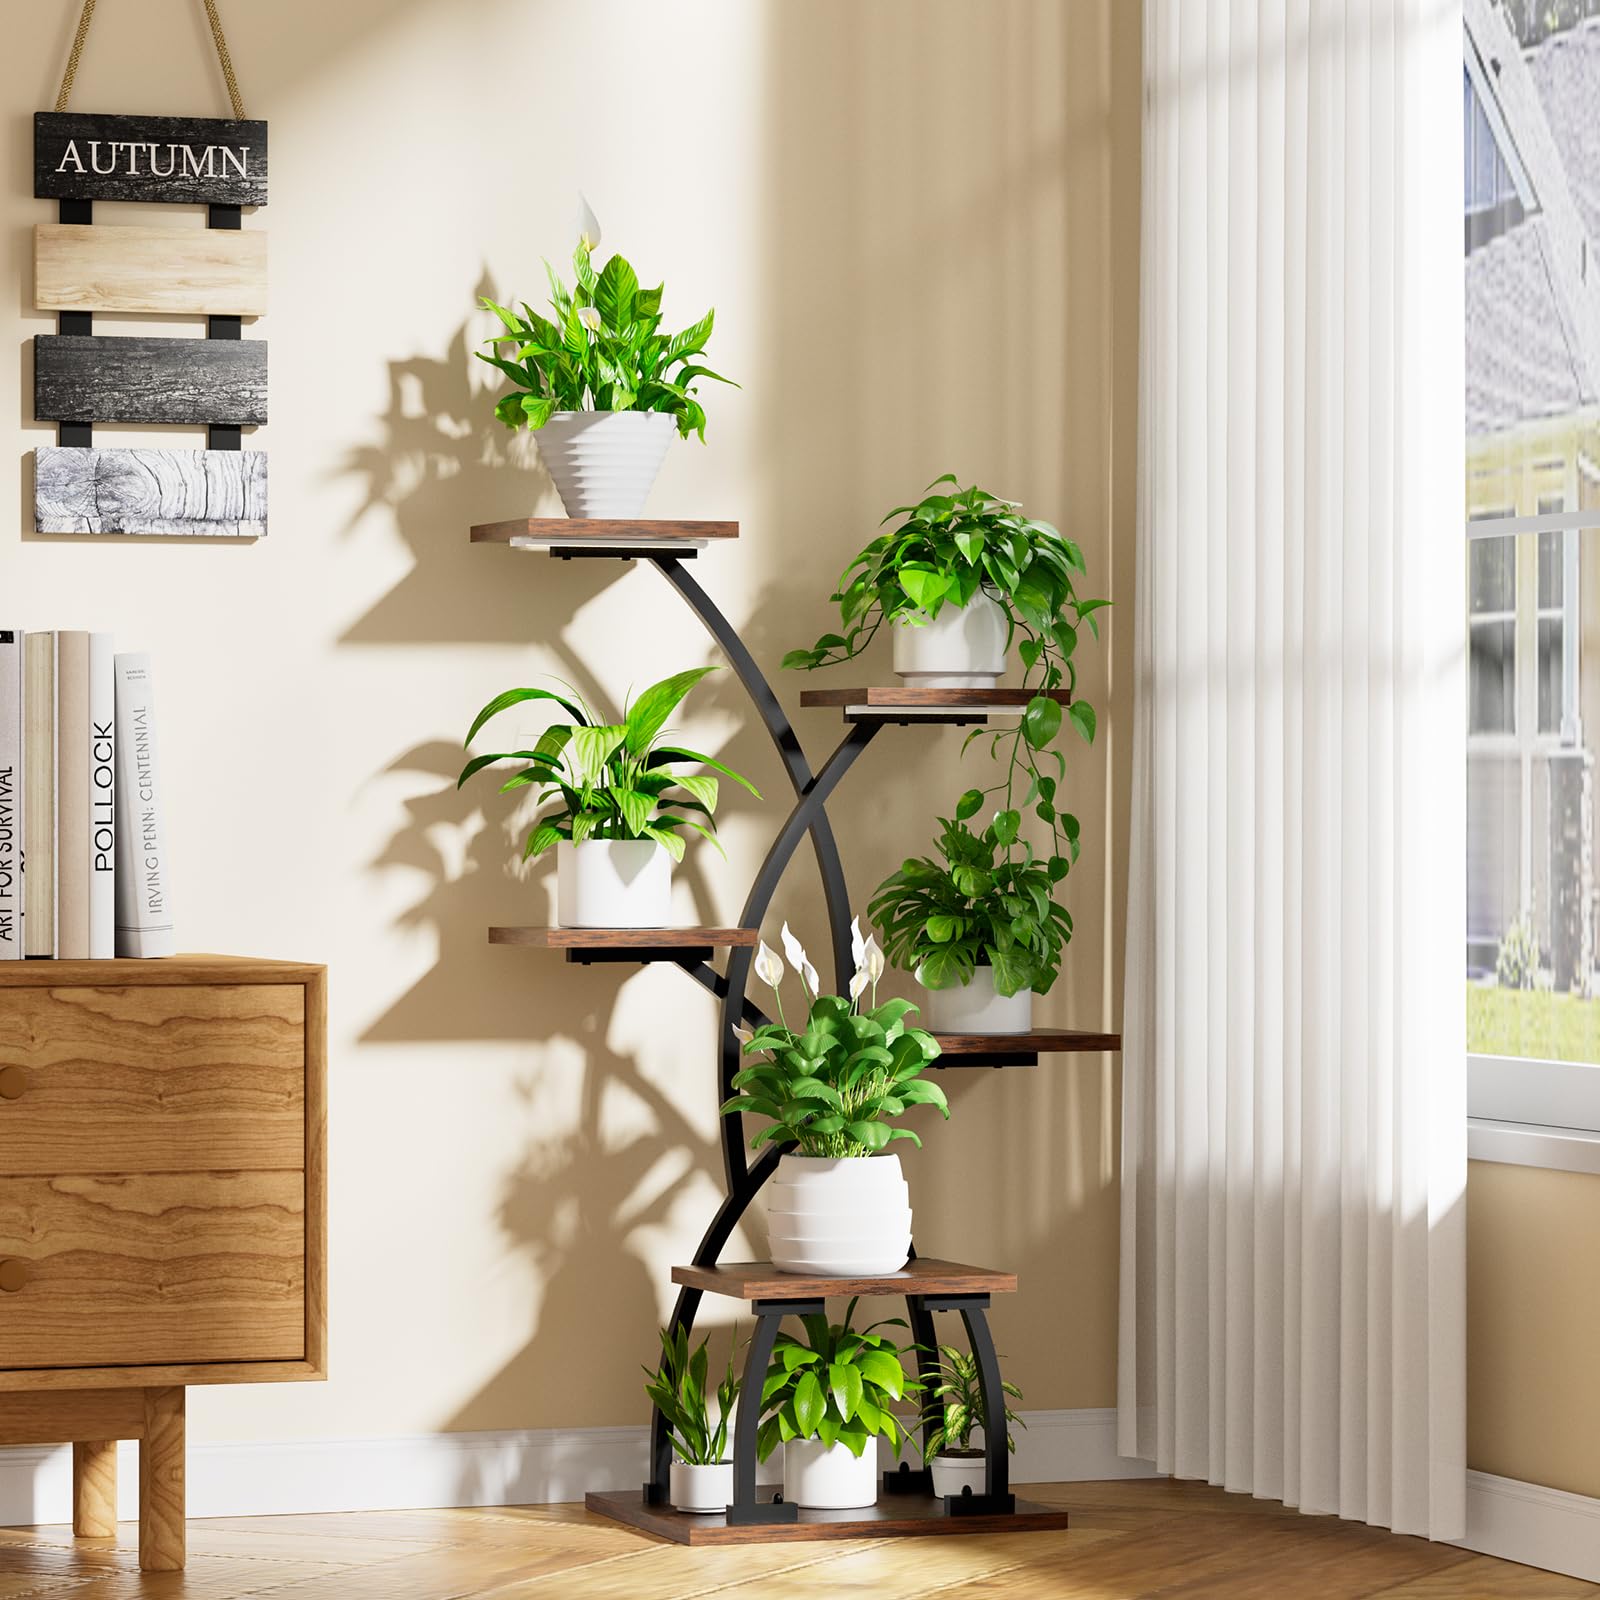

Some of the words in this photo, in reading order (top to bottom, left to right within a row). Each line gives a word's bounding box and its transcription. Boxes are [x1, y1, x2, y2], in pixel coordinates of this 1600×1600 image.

[55, 139, 250, 179] AUTUMN
[133, 705, 153, 802] CENTENNIAL
[93, 721, 113, 872] POLLOCK
[142, 807, 157, 851] PENN:
[145, 856, 162, 914] IRVING
